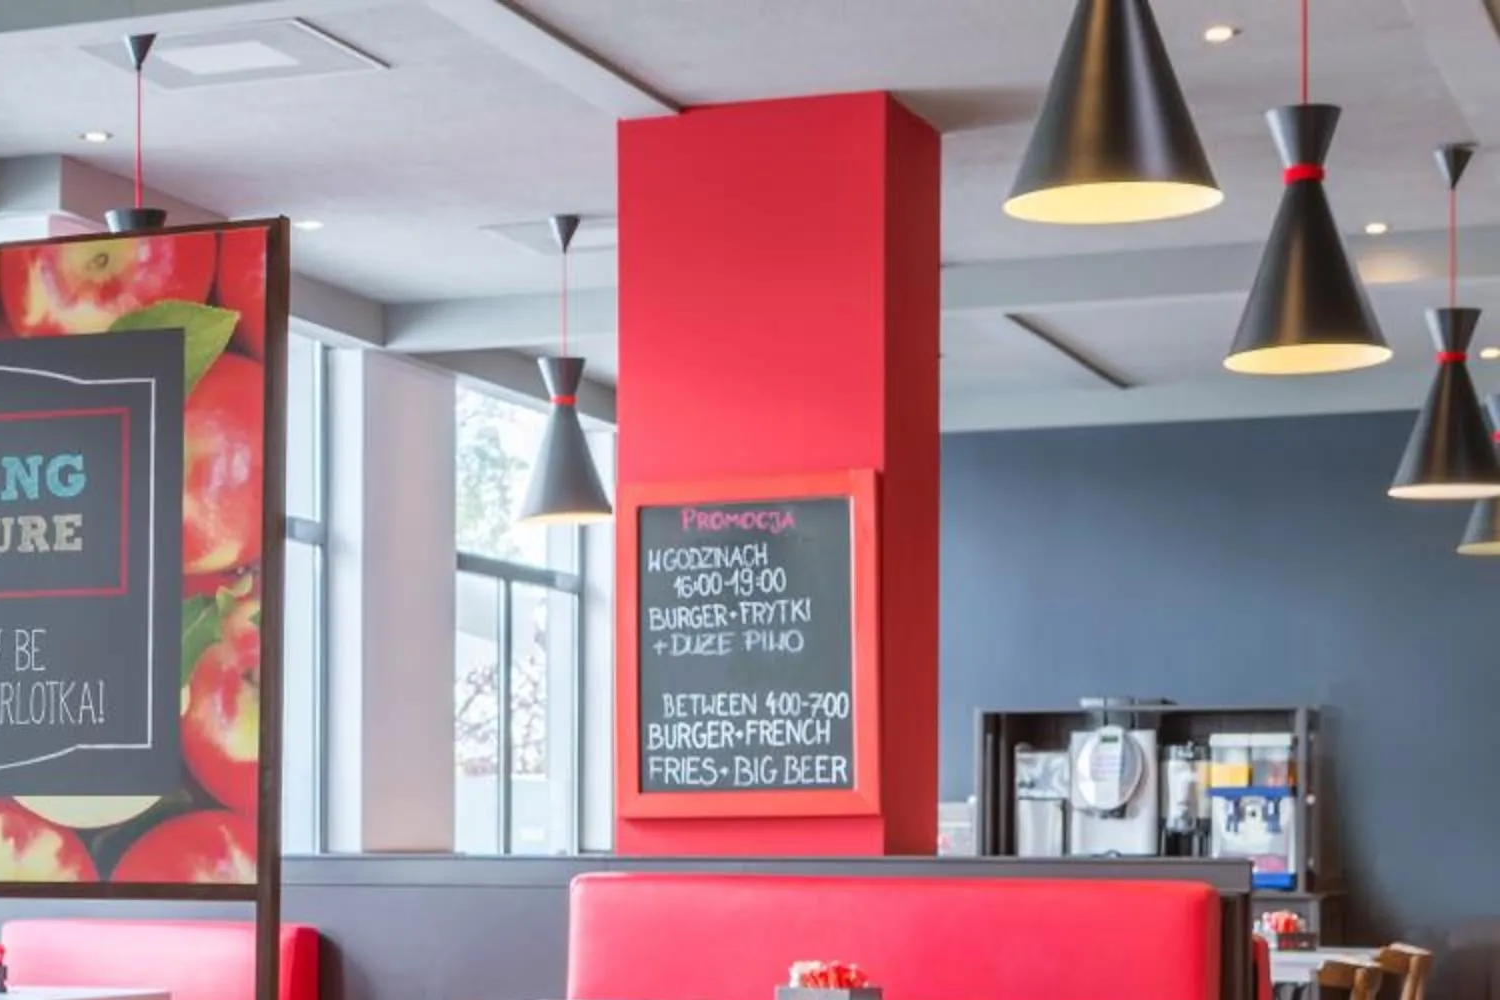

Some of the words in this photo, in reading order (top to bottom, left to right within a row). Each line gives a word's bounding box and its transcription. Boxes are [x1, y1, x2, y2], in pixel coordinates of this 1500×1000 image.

[15, 628, 47, 672] BE
[742, 629, 805, 653] PIWO
[661, 692, 757, 718] BETWEEN
[733, 755, 778, 787] BIG
[783, 754, 848, 785] BEER
